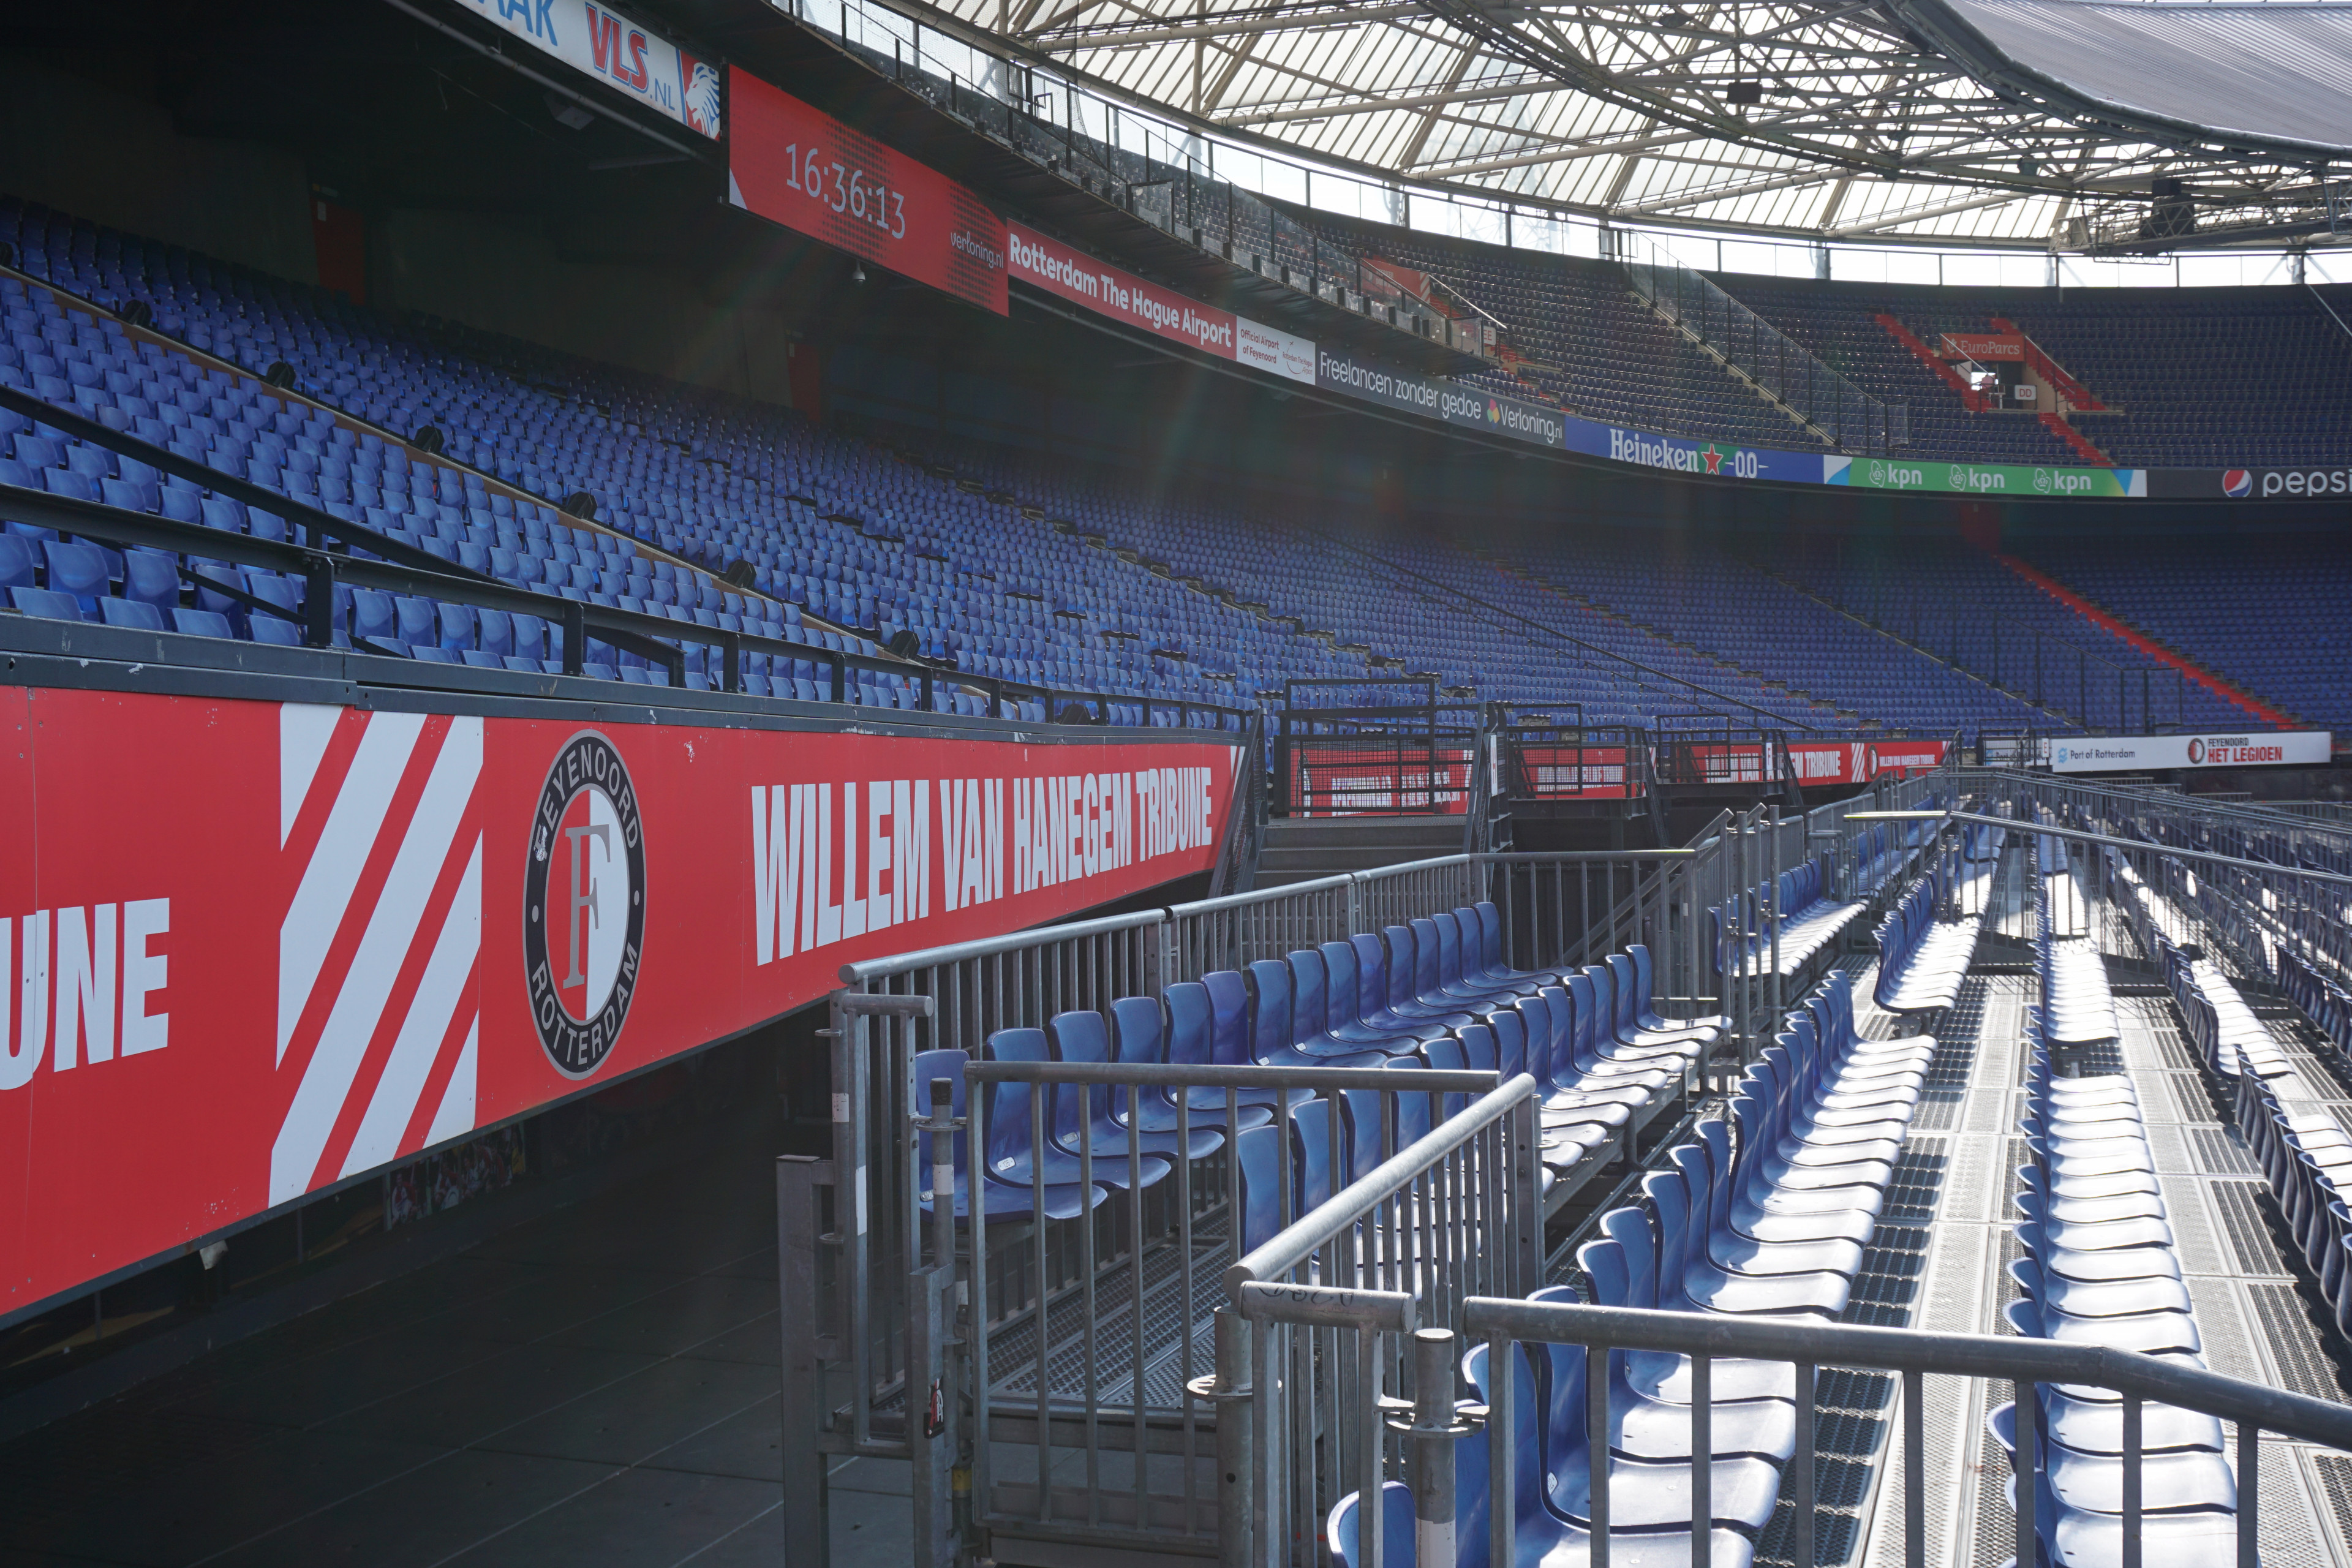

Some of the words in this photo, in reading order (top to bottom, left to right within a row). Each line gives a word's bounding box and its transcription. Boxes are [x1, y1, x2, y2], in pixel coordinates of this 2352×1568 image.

[786, 143, 905, 239] 16:36:13
[951, 230, 1004, 269] verloning.nl
[1010, 233, 1098, 298] Rotterdam
[1101, 274, 1129, 310] The
[1133, 286, 1179, 330] Hague
[1182, 311, 1232, 348] Airport
[1240, 328, 1261, 344] Official
[1261, 335, 1280, 350] Airport
[1961, 340, 2020, 355] EuroParcs
[1243, 345, 1249, 355] of
[1250, 347, 1277, 364] Feyenoord
[1282, 351, 1297, 362] Rotterdam
[1303, 357, 1313, 368] Hague
[1302, 366, 1313, 376] Airport
[1320, 351, 1392, 396] Freelancen
[1395, 379, 1439, 409] zonder
[1442, 391, 1482, 420] gedoe
[2019, 388, 2032, 398] DD
[1610, 429, 1700, 472] Heineken
[1888, 463, 1923, 489] kpn
[1969, 467, 2005, 492] kpn
[2054, 470, 2092, 494] kpn
[2070, 750, 2084, 760] Port
[2086, 748, 2094, 759] of
[2095, 748, 2136, 759] Rotterdam
[2208, 737, 2249, 747] FEYENOORD
[1804, 751, 1841, 778] TRIBUNE
[1879, 756, 1893, 767] WILLEM
[1901, 755, 1920, 766] HANEGEM
[1920, 754, 1936, 765] TRIBUNE
[2208, 748, 2230, 763] HET
[2233, 747, 2283, 763] LEGIOEN
[534, 744, 638, 861] FEYENOORD
[751, 780, 930, 967] WILLEM
[940, 778, 1003, 913] VAN
[1014, 772, 1132, 895] HANEGEM
[1136, 767, 1213, 862] TRIBUNE
[532, 941, 638, 1066] ROTTERDAM
